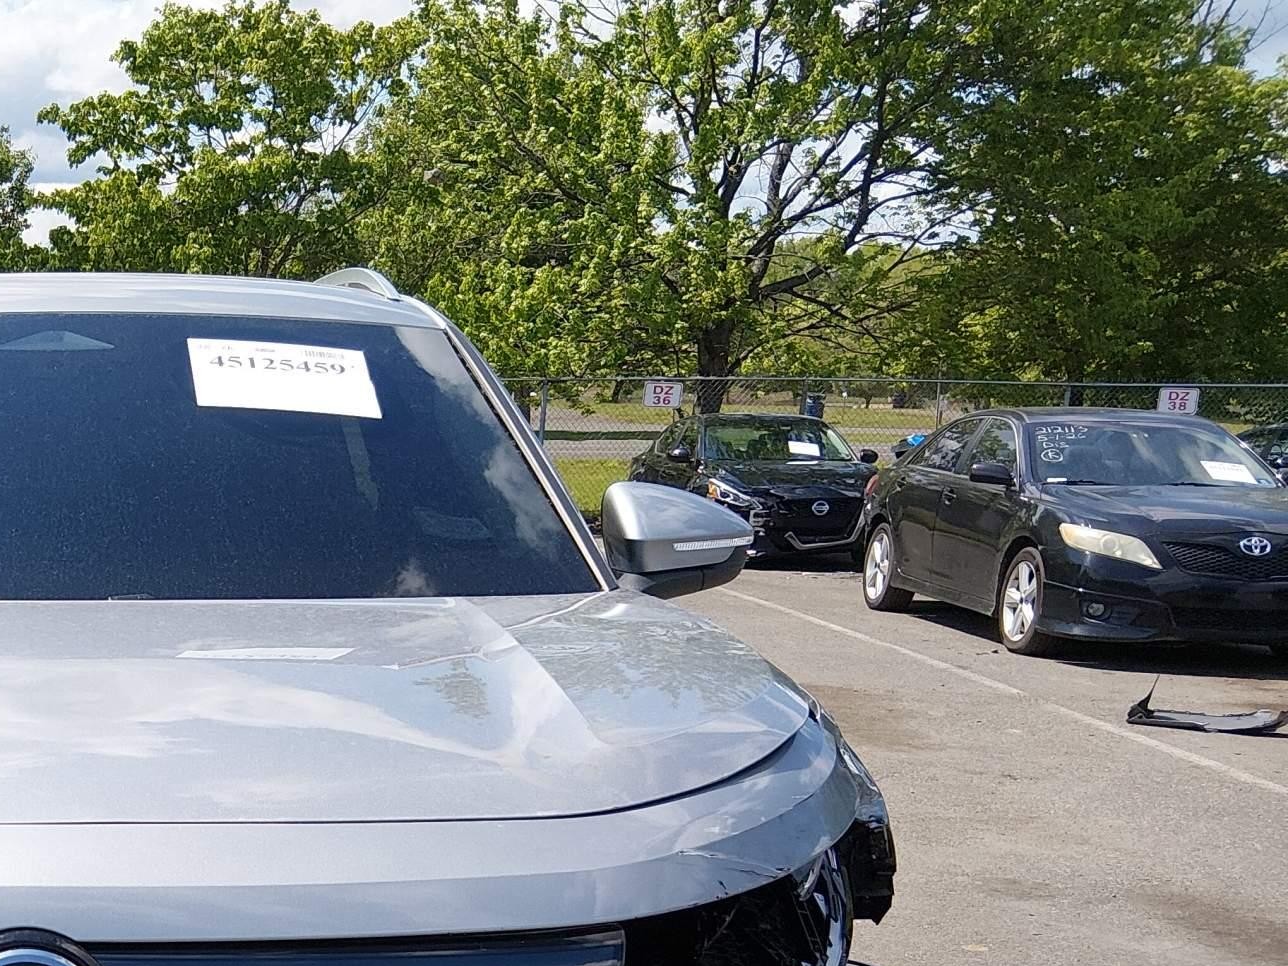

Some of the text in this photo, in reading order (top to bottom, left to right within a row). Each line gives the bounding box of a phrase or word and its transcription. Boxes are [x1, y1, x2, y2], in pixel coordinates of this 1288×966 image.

[209, 355, 346, 375] 45125459
[653, 385, 674, 395] DZ
[653, 395, 671, 405] 36
[1168, 391, 1190, 401] DZ
[1168, 401, 1187, 411] 38
